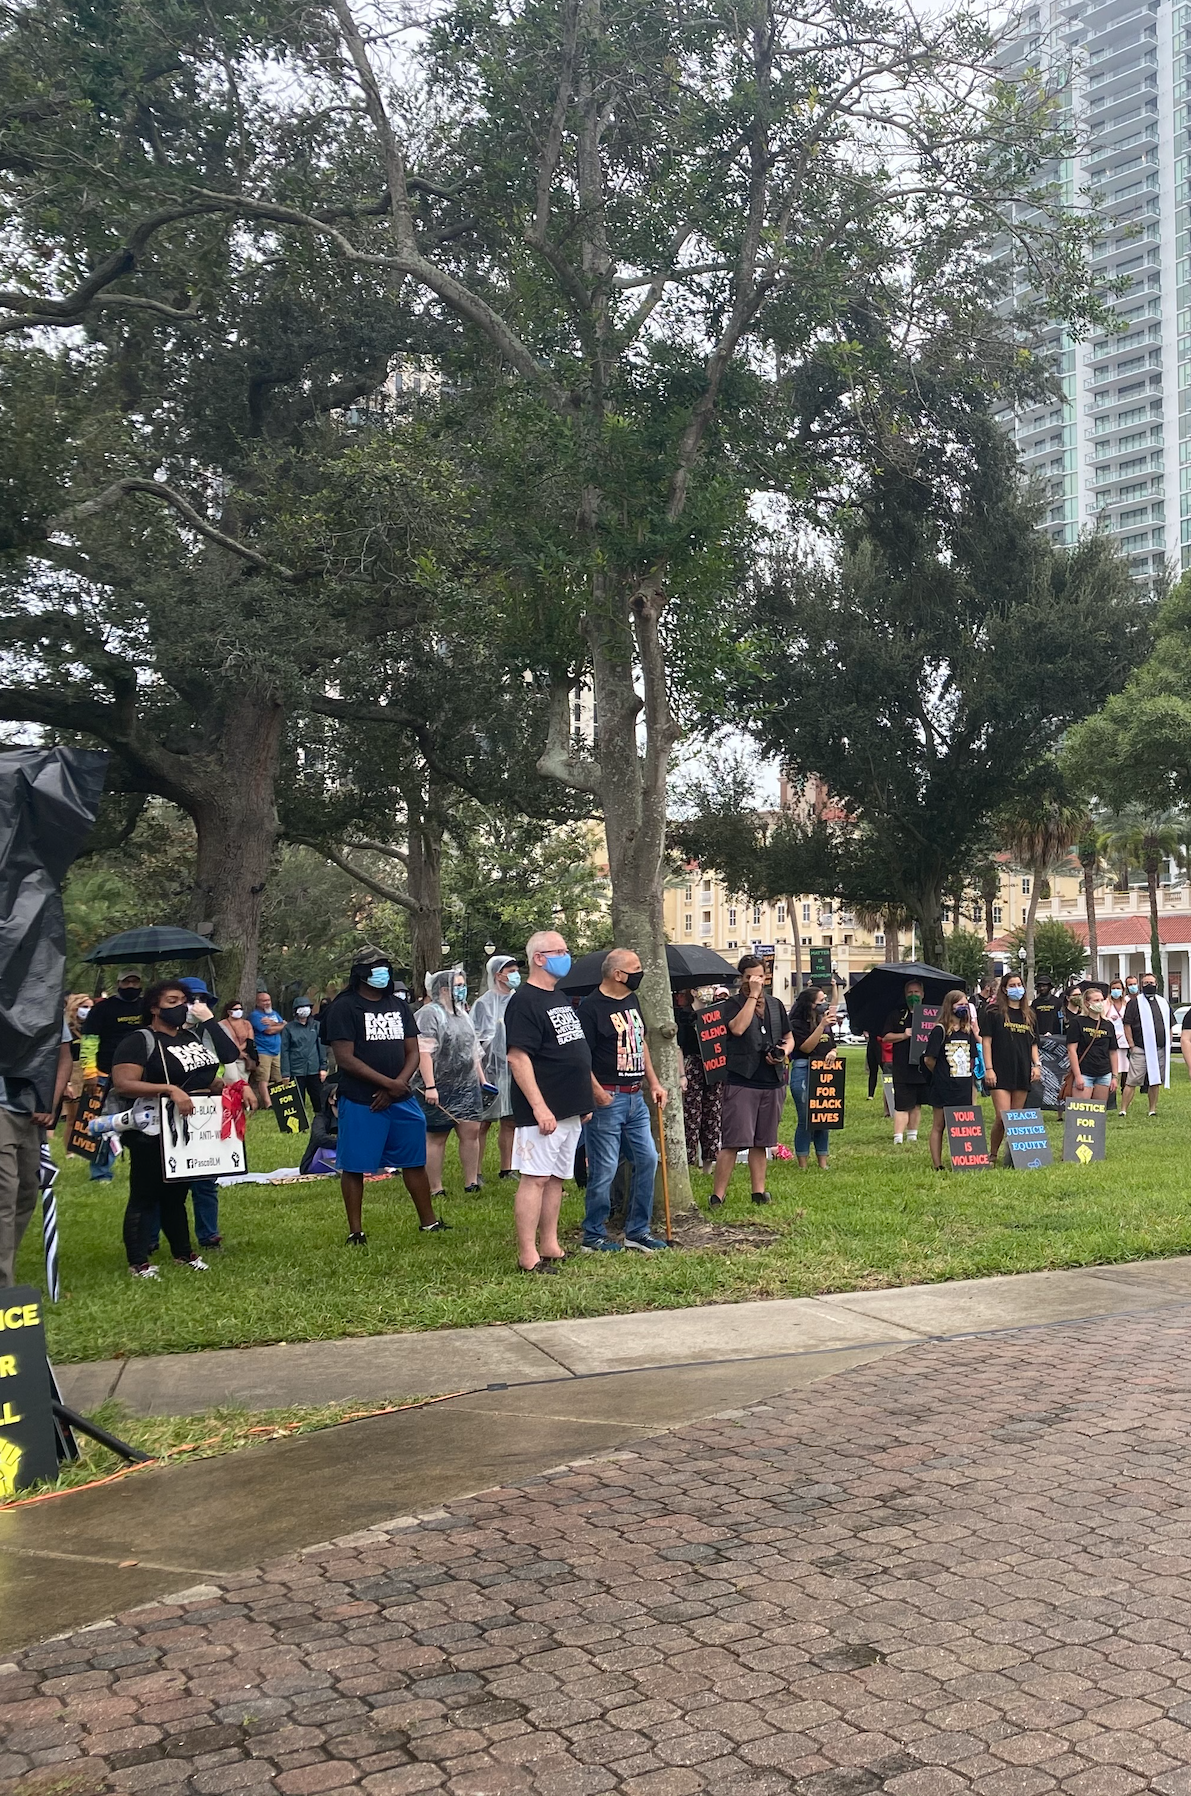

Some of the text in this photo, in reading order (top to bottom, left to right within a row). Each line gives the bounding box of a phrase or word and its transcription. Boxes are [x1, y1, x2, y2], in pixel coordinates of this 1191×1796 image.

[364, 1011, 402, 1021] BLACK
[702, 1010, 721, 1024] YOUR
[923, 1007, 939, 1017] SAY
[365, 1020, 403, 1028] LIVES
[366, 1027, 404, 1035] MATTER
[916, 1034, 929, 1043] NA
[714, 1043, 722, 1054] IS
[703, 1056, 727, 1072] VIOLE
[811, 1060, 843, 1070] SPEAK
[820, 1074, 834, 1083] UP
[816, 1087, 836, 1097] FOR
[88, 1098, 101, 1110] UP
[279, 1095, 294, 1105] FOR
[809, 1099, 842, 1109] BLACK
[283, 1107, 297, 1117] ALL
[1067, 1101, 1106, 1113] JUSTICE
[82, 1110, 95, 1121] FO
[811, 1113, 839, 1123] LIVES
[953, 1111, 975, 1122] YOUR
[1006, 1111, 1038, 1121] PEACE
[1076, 1118, 1095, 1128] FOR
[950, 1126, 983, 1138] SILENCE
[1006, 1126, 1046, 1136] JUSTICE
[1076, 1134, 1095, 1144] ALL
[72, 1136, 96, 1153] LIVES
[964, 1142, 973, 1152] IS
[1011, 1140, 1048, 1151] EQUITY
[951, 1154, 990, 1167] VIOLENCE
